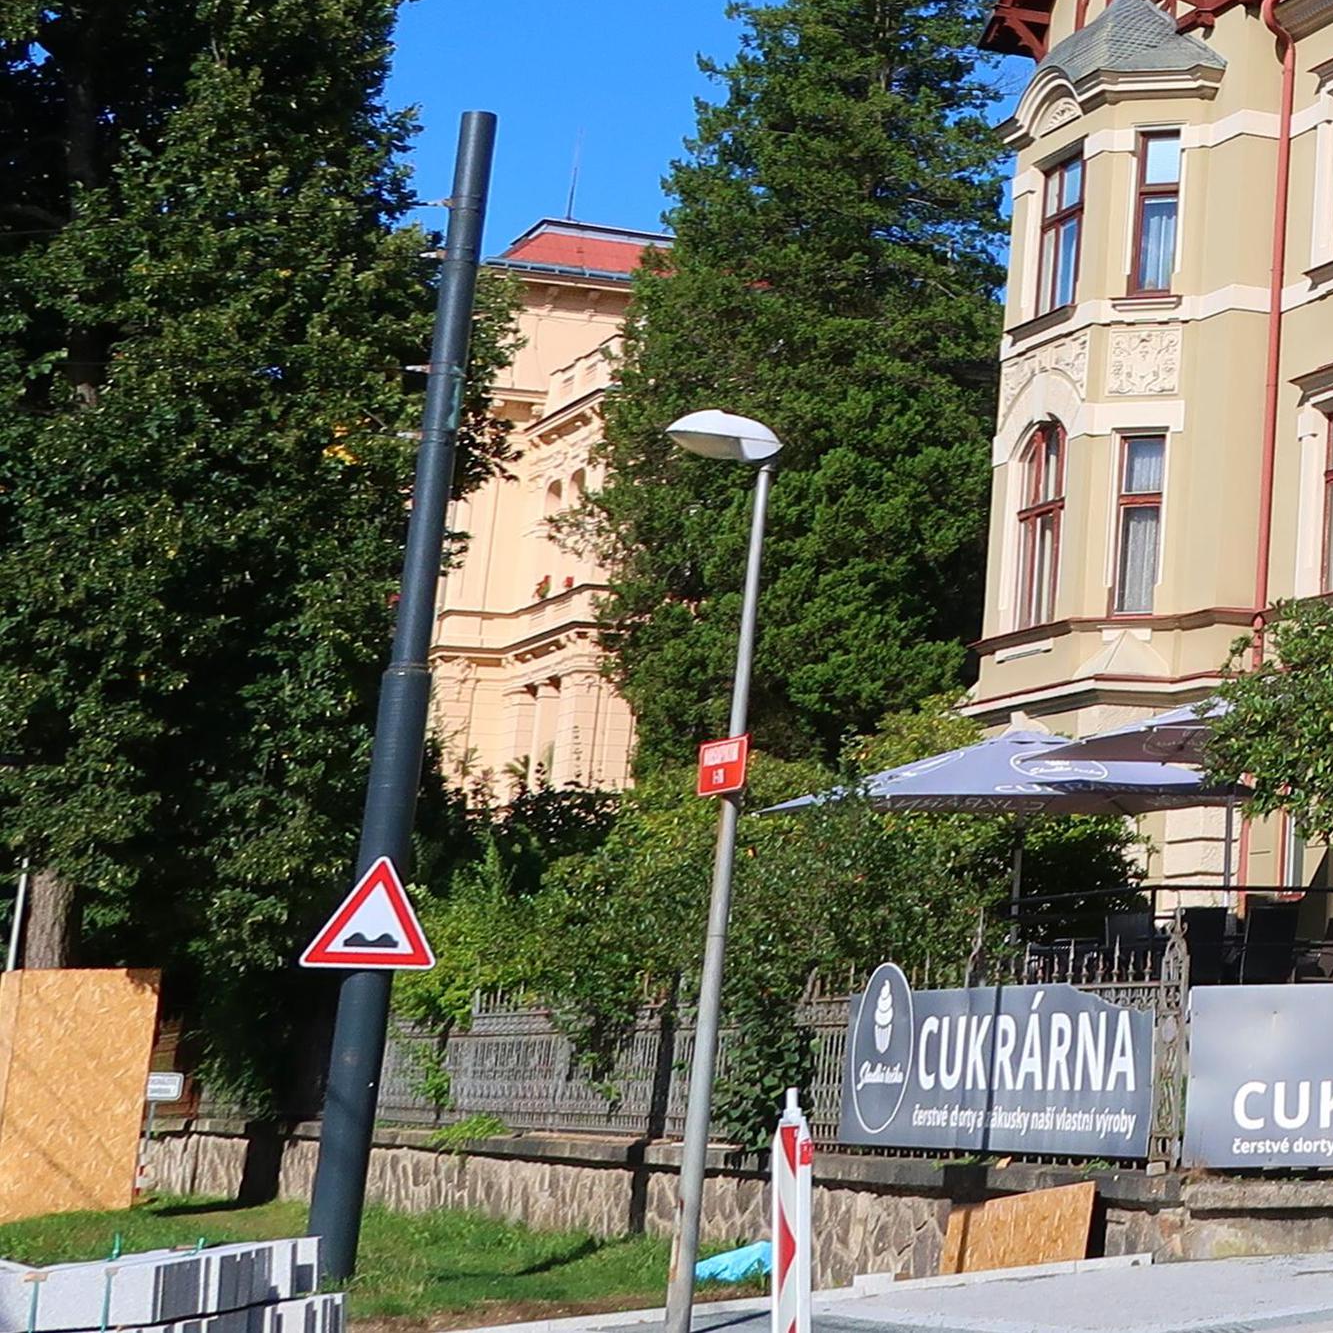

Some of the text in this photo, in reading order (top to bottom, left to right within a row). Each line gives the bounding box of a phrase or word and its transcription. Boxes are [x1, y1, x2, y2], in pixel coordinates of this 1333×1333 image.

[918, 991, 1136, 1092] CUKRÁRNA
[912, 1104, 949, 1127] čerstvé
[950, 1104, 977, 1135] dorty
[977, 1110, 984, 1128] a
[1030, 1106, 1056, 1130] naší
[1056, 1107, 1096, 1131] vlastní
[1096, 1107, 1137, 1140] výroby
[1232, 1137, 1290, 1154] čerstvé
